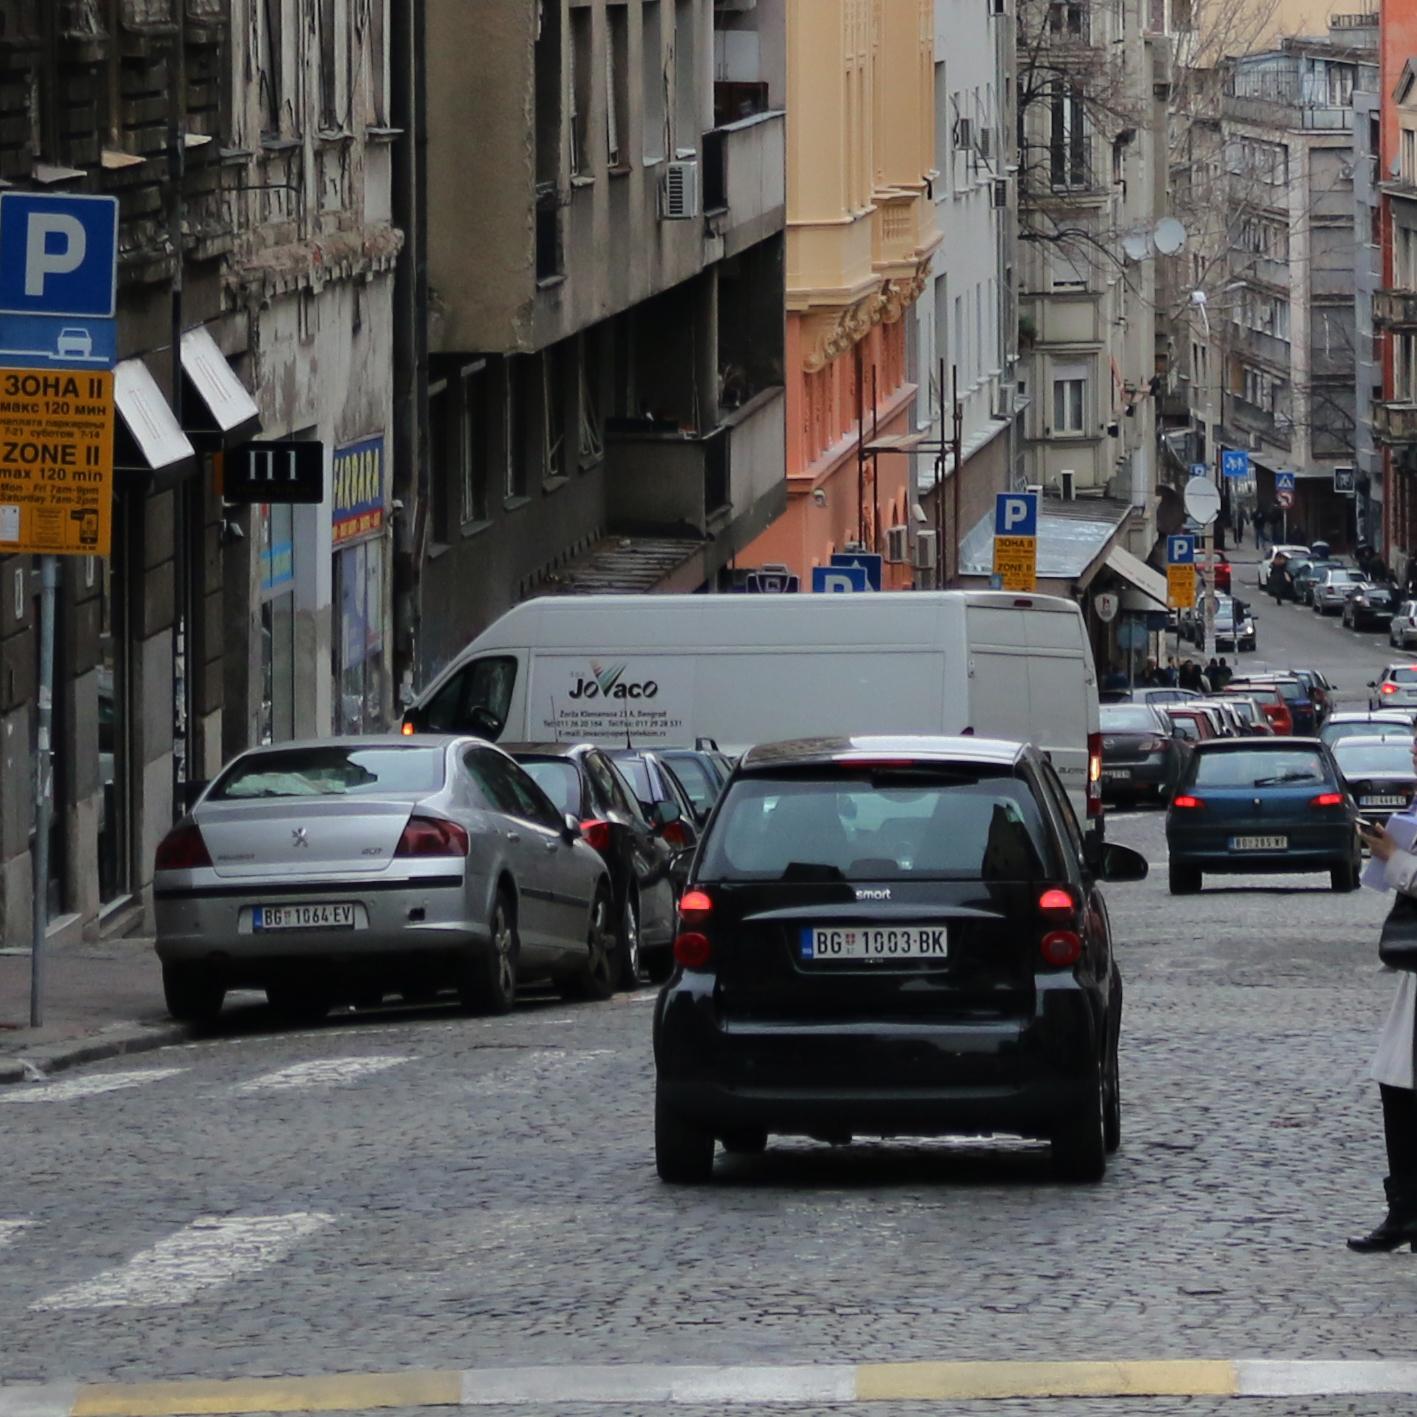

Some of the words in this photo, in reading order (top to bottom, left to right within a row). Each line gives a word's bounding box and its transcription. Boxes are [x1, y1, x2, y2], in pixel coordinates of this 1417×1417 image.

[25, 212, 86, 296] P
[4, 375, 79, 398] ЗОНА
[88, 378, 103, 399] II
[0, 402, 40, 414] макс
[44, 401, 70, 415] 120
[74, 405, 106, 416] мин
[0, 418, 42, 428] наплата
[30, 429, 74, 441] суботом
[2, 442, 76, 465] ZONE
[86, 446, 100, 466] II
[39, 467, 66, 481] 120
[72, 468, 103, 482] min
[0, 483, 23, 492] Mon
[33, 483, 46, 493] Fri
[0, 493, 47, 505] Saturday
[1005, 499, 1027, 530] P
[1173, 540, 1188, 561] P
[855, 888, 892, 900] smart
[265, 909, 282, 926] BG
[817, 932, 842, 954] BG
